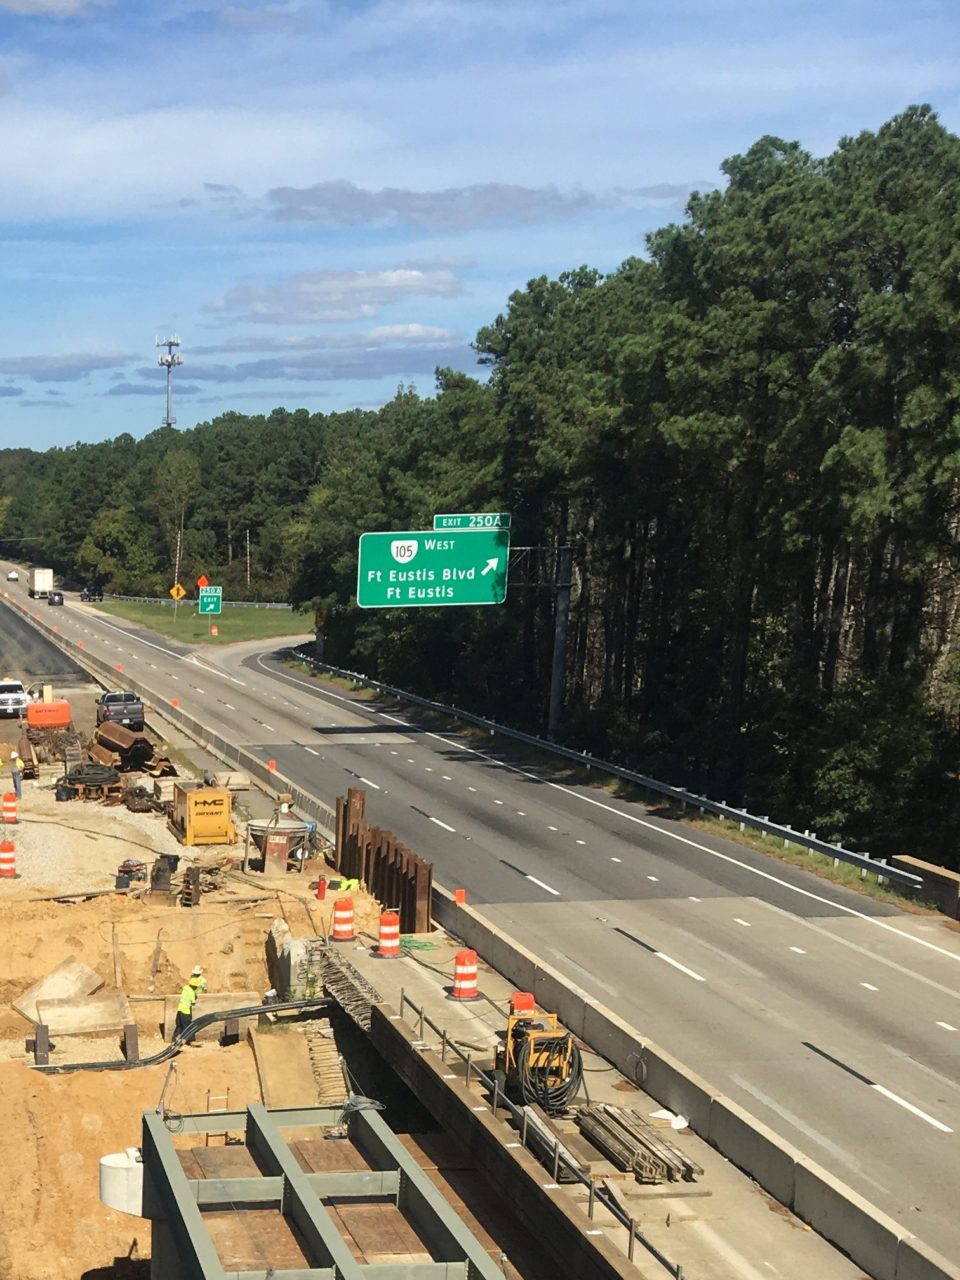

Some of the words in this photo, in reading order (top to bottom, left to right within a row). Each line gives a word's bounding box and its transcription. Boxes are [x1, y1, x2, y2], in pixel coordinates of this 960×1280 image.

[443, 517, 461, 527] EXIT
[469, 516, 501, 527] 250A
[424, 539, 455, 551] WEST
[395, 545, 413, 562] 105
[368, 570, 382, 582] Ft
[390, 568, 435, 582] Eustis
[442, 567, 475, 580] Blvd
[387, 587, 400, 599] Ft
[408, 585, 454, 599] Eustis
